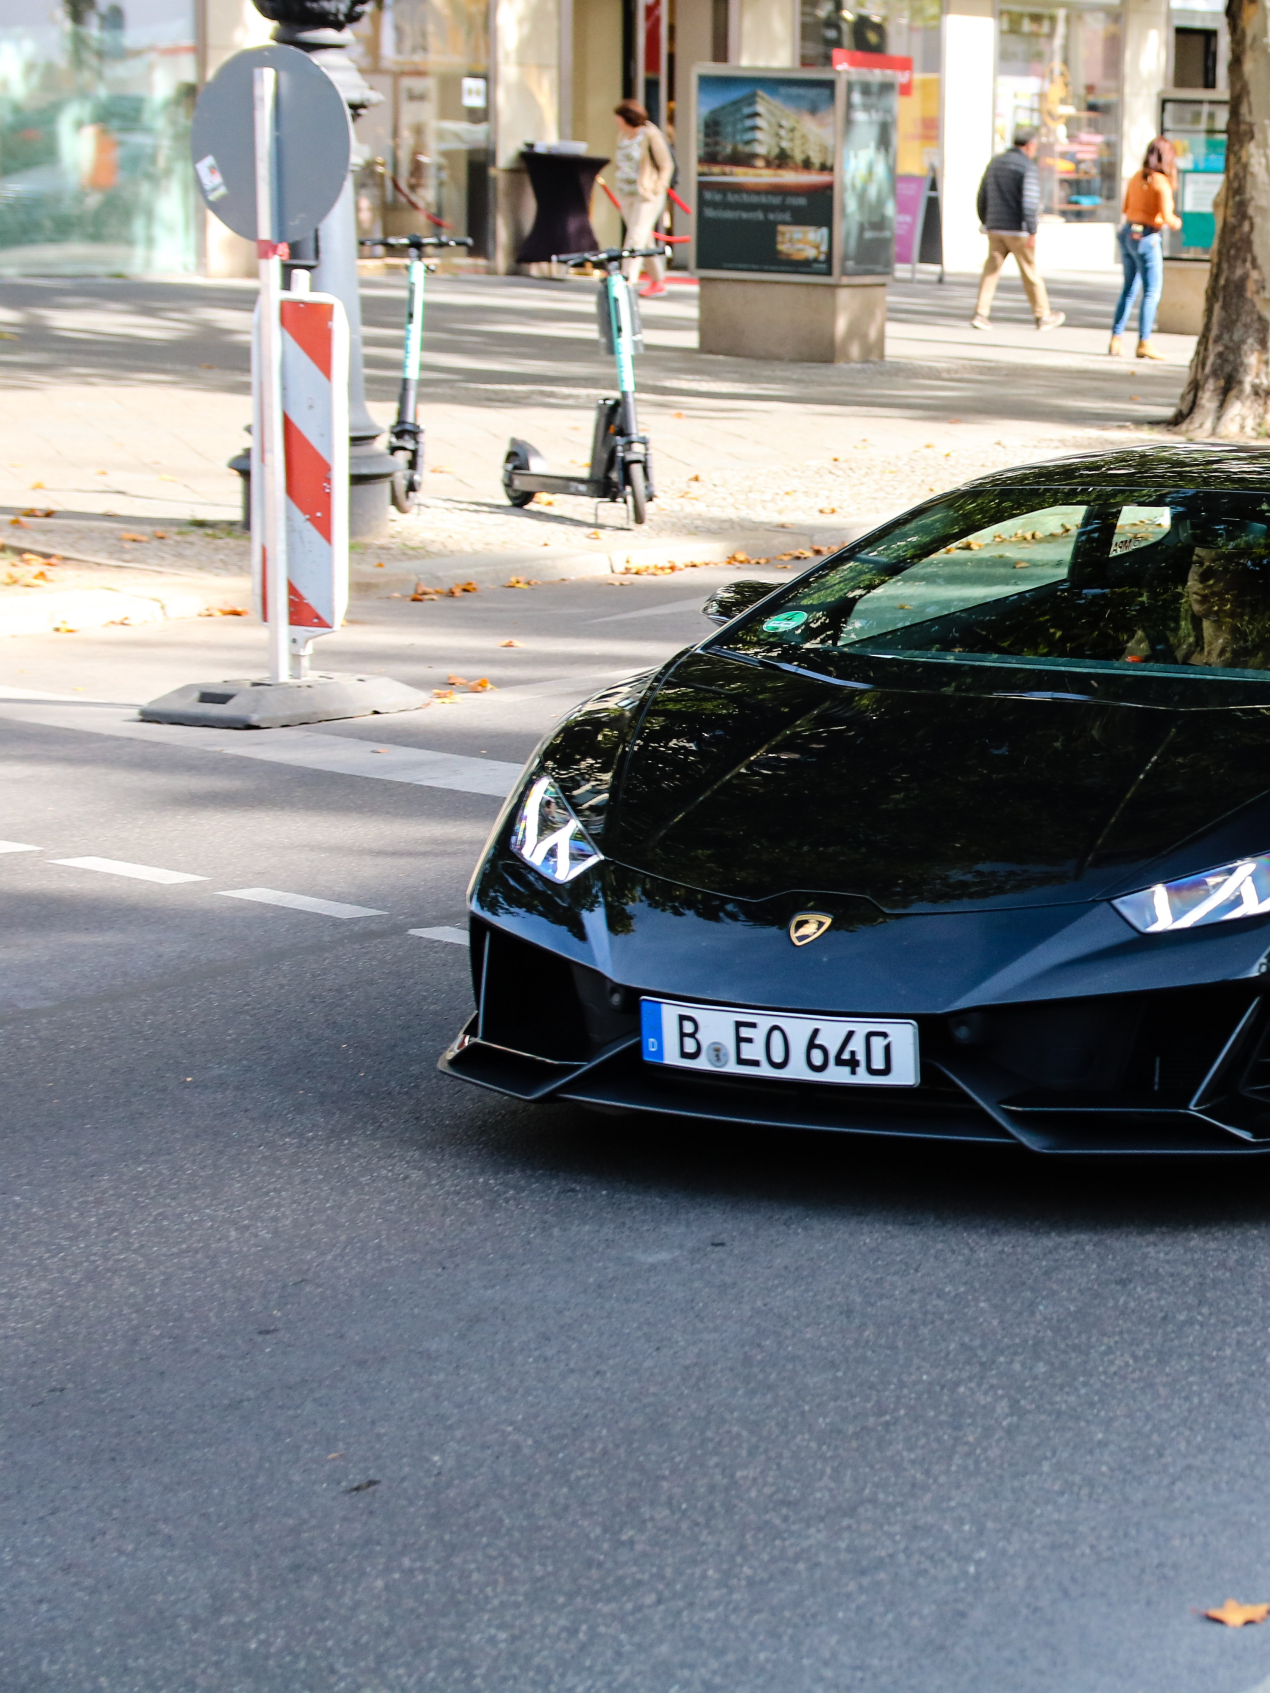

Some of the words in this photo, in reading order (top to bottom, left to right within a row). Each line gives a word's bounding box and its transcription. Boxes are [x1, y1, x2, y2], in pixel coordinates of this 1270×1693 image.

[648, 1038, 658, 1051] D
[677, 1013, 701, 1060] B
[734, 1020, 790, 1069] EO
[806, 1028, 892, 1076] 640
